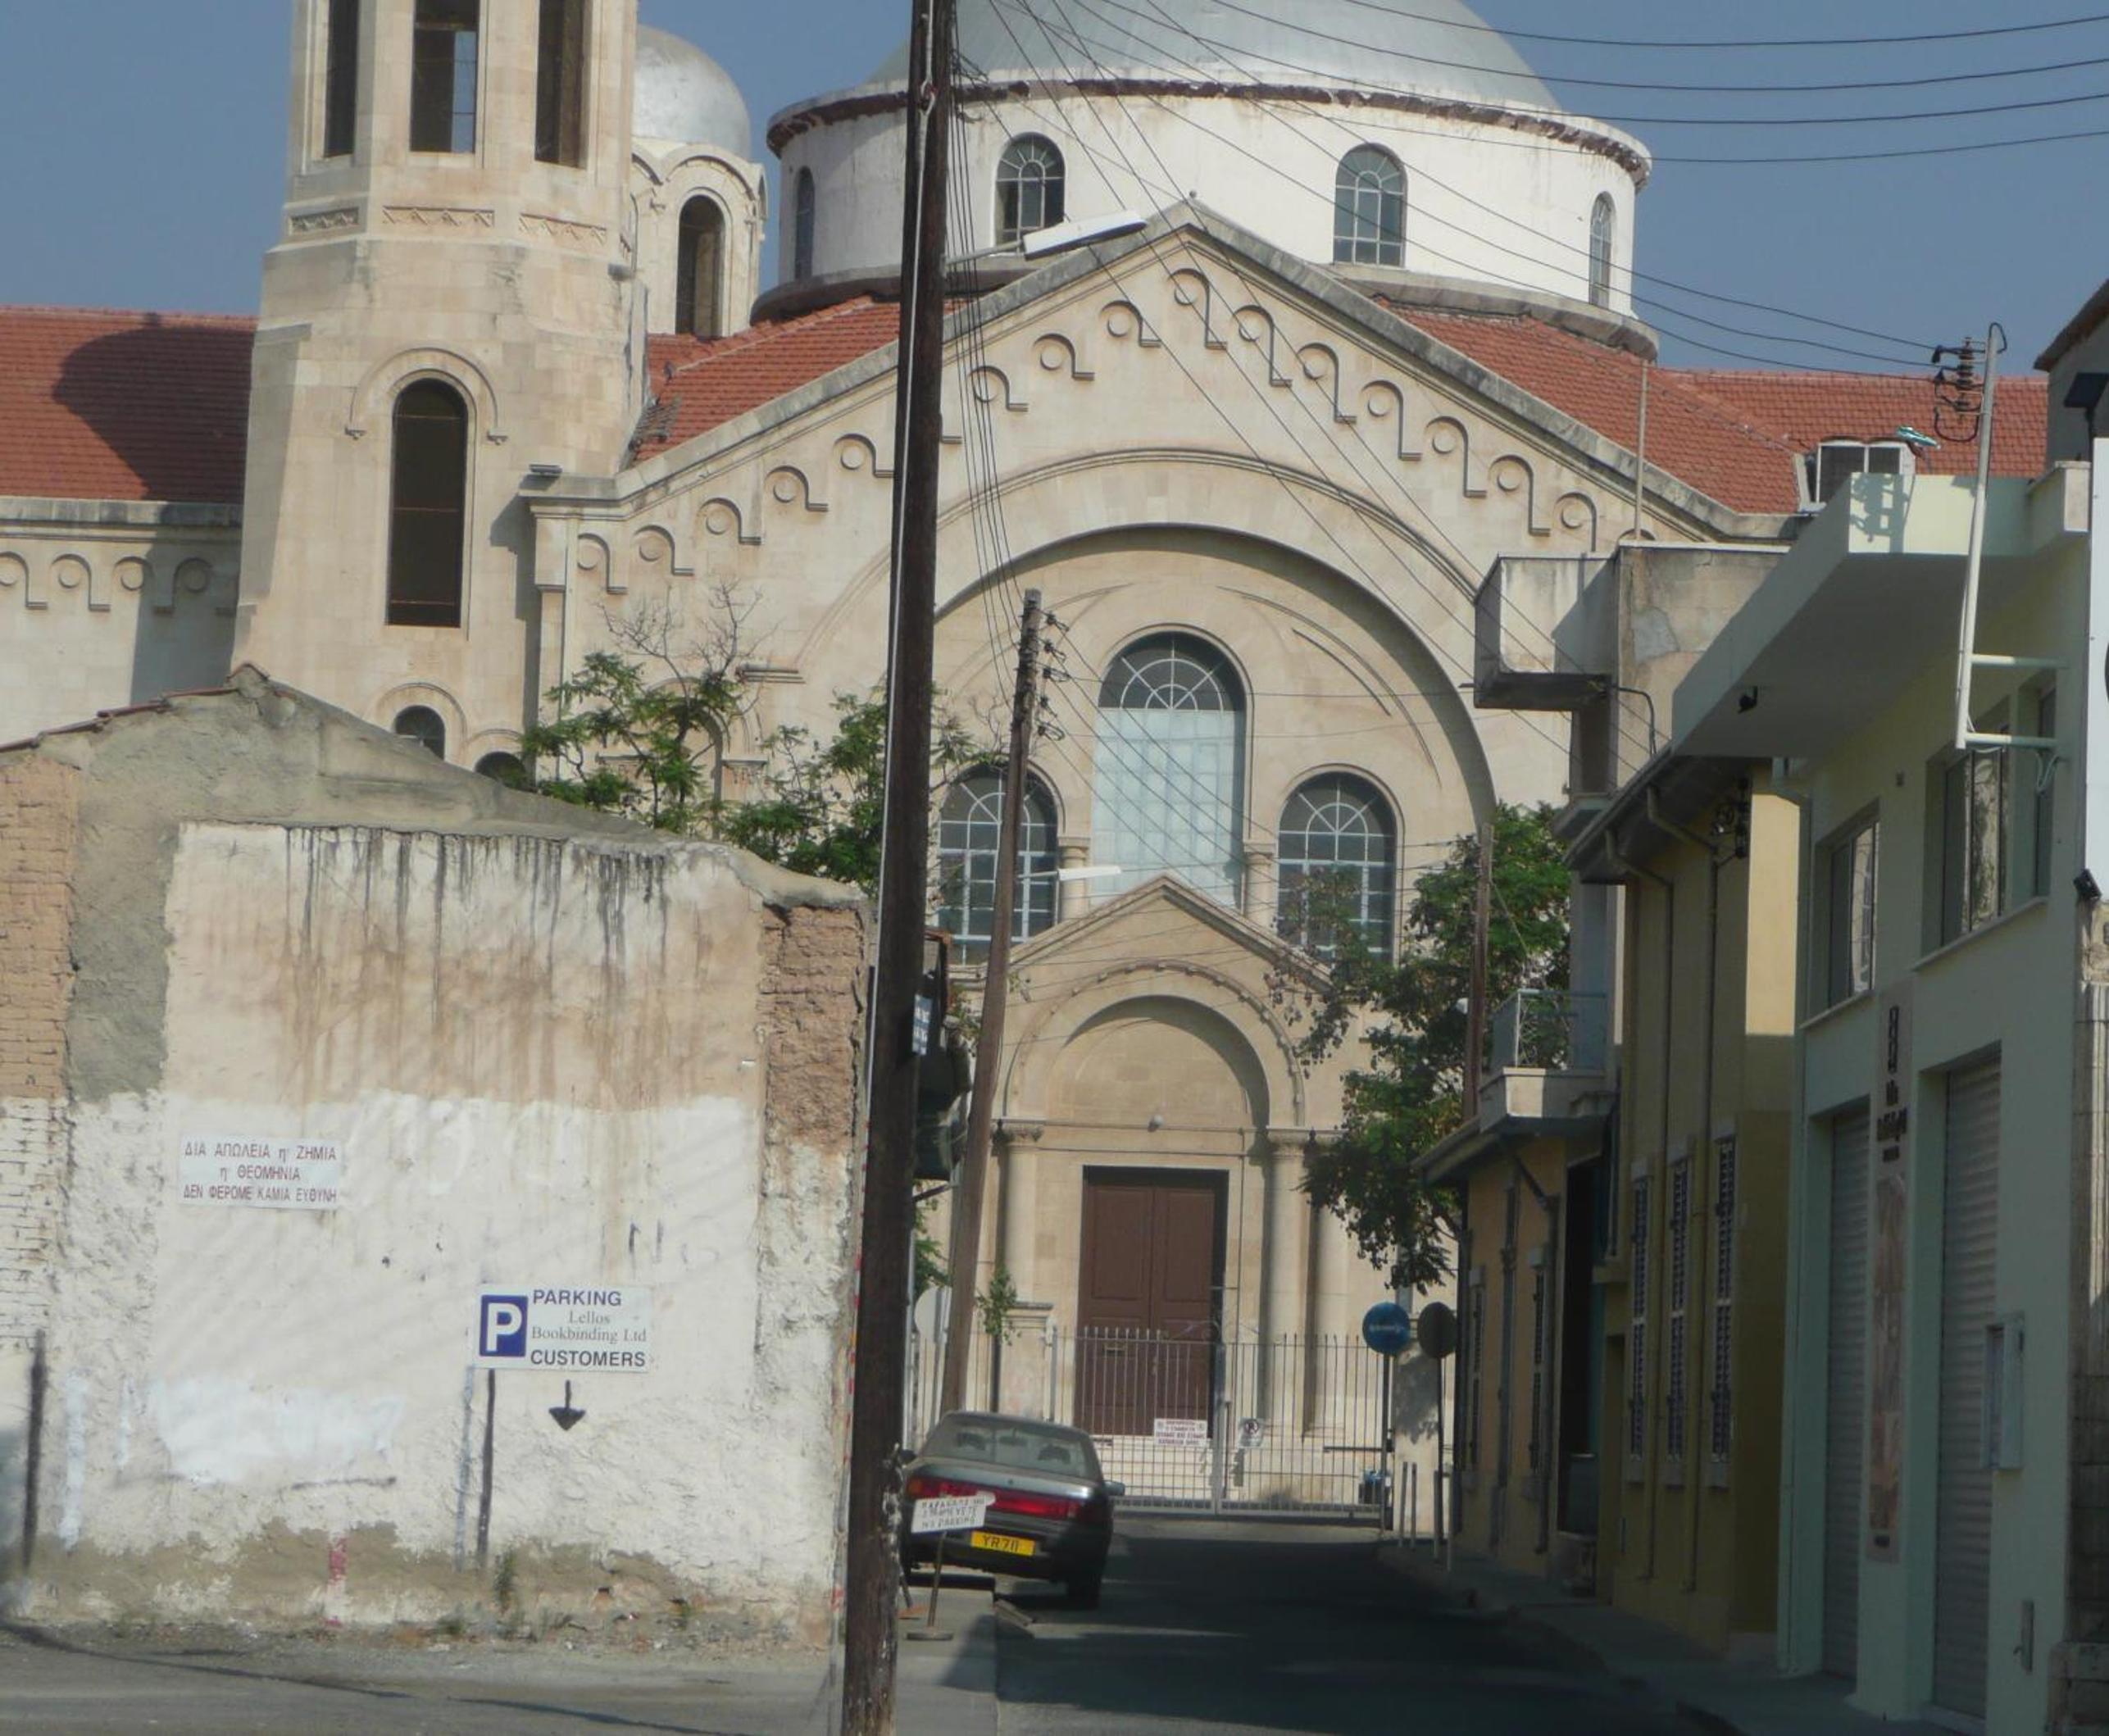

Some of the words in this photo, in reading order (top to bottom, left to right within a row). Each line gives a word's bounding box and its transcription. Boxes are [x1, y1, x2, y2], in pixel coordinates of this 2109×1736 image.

[184, 1141, 207, 1157] ΔΙΑ
[214, 1143, 270, 1158] ΑΠΩΛΕΙΑ
[296, 1145, 337, 1161] ΖΗΜΙΑ
[237, 1165, 301, 1181] ΘΕΟΜΗΝΙΑ
[183, 1184, 203, 1199] ΔΕΝ
[257, 1188, 290, 1202] ΚΑΜΙΑ
[296, 1188, 337, 1203] ΕΥΘΥΝΗ
[533, 1289, 622, 1307] PARKING
[568, 1310, 611, 1325] Lellos
[485, 1302, 523, 1352] P
[532, 1327, 619, 1345] Bookbinding
[623, 1328, 647, 1343] Ltd
[530, 1349, 646, 1367] CUSTOMERS
